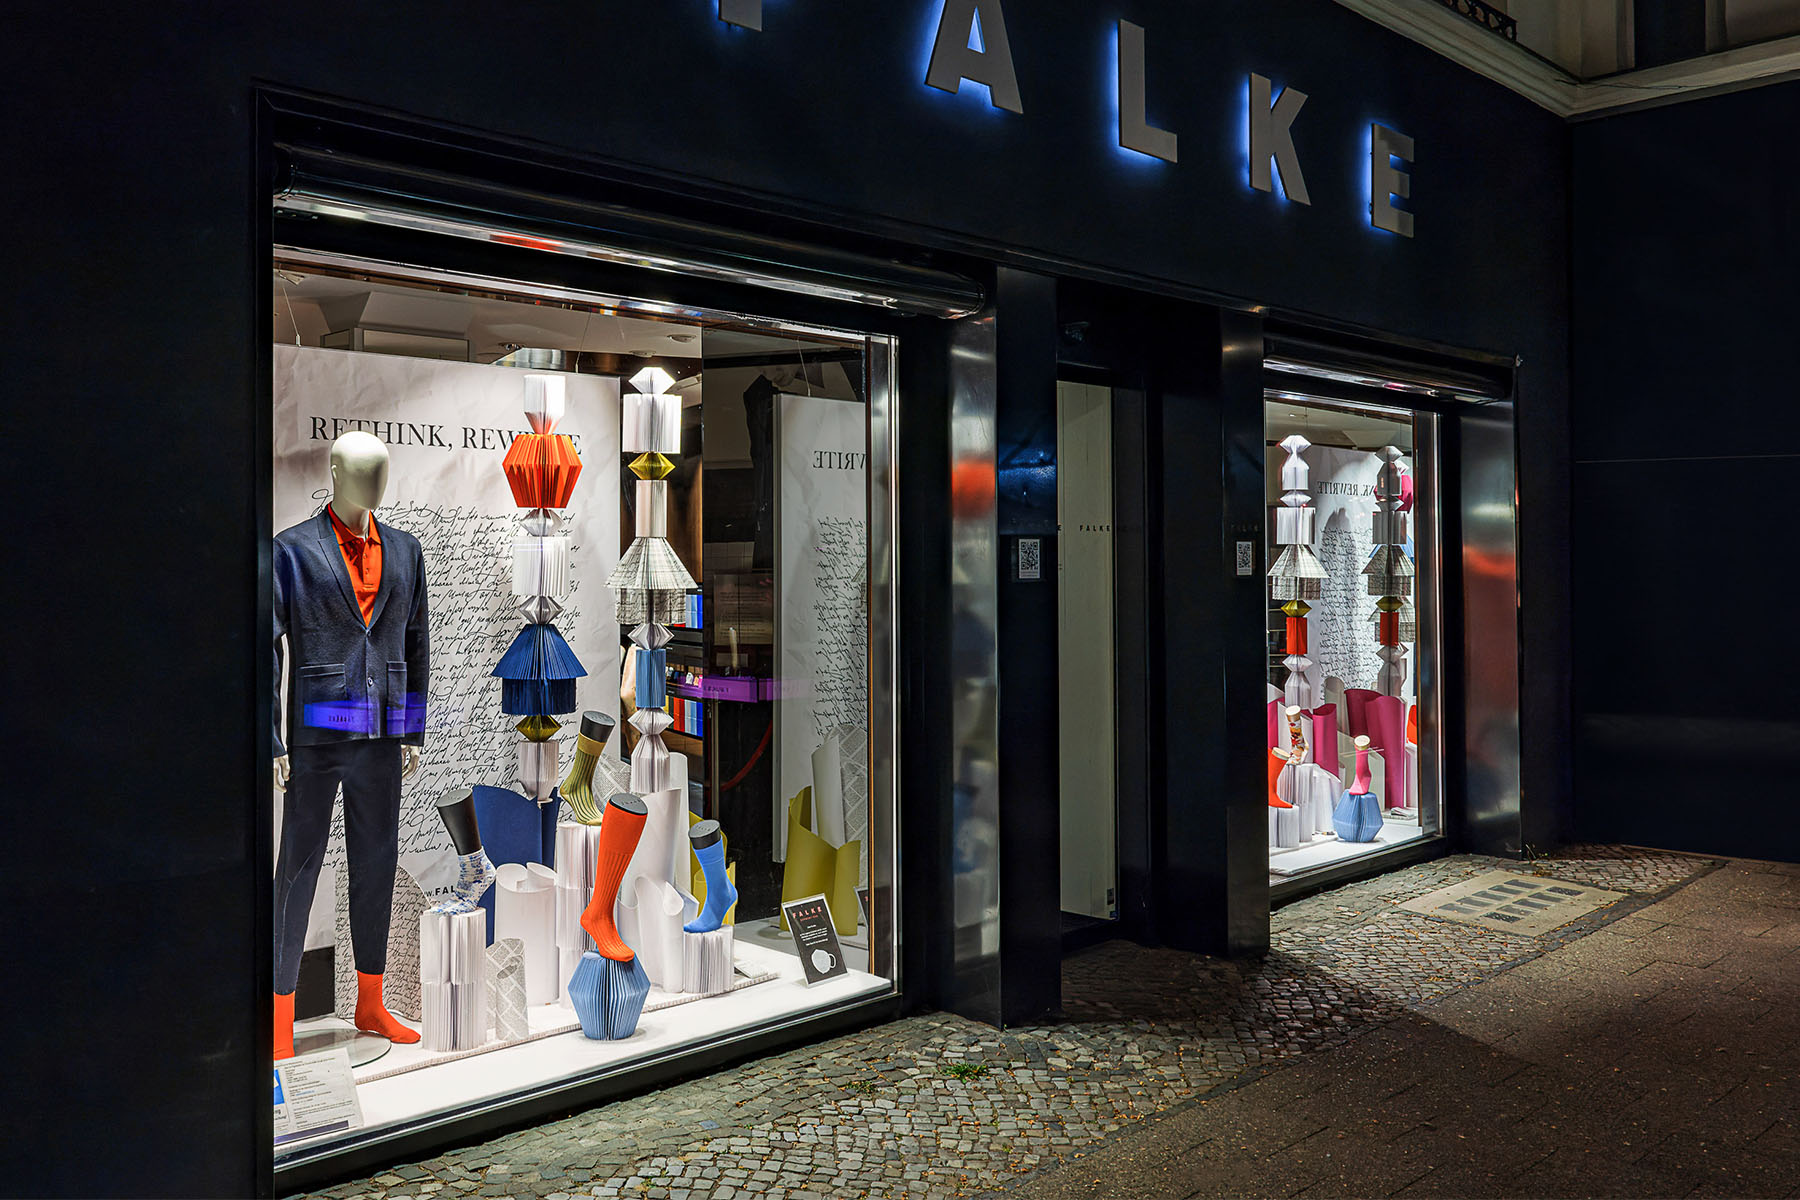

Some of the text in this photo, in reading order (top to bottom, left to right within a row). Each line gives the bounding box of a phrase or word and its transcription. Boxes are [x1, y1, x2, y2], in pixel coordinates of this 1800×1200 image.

[719, 0, 1415, 238] ALKE
[1079, 524, 1110, 532] FALKE
[792, 906, 822, 919] FALKE
